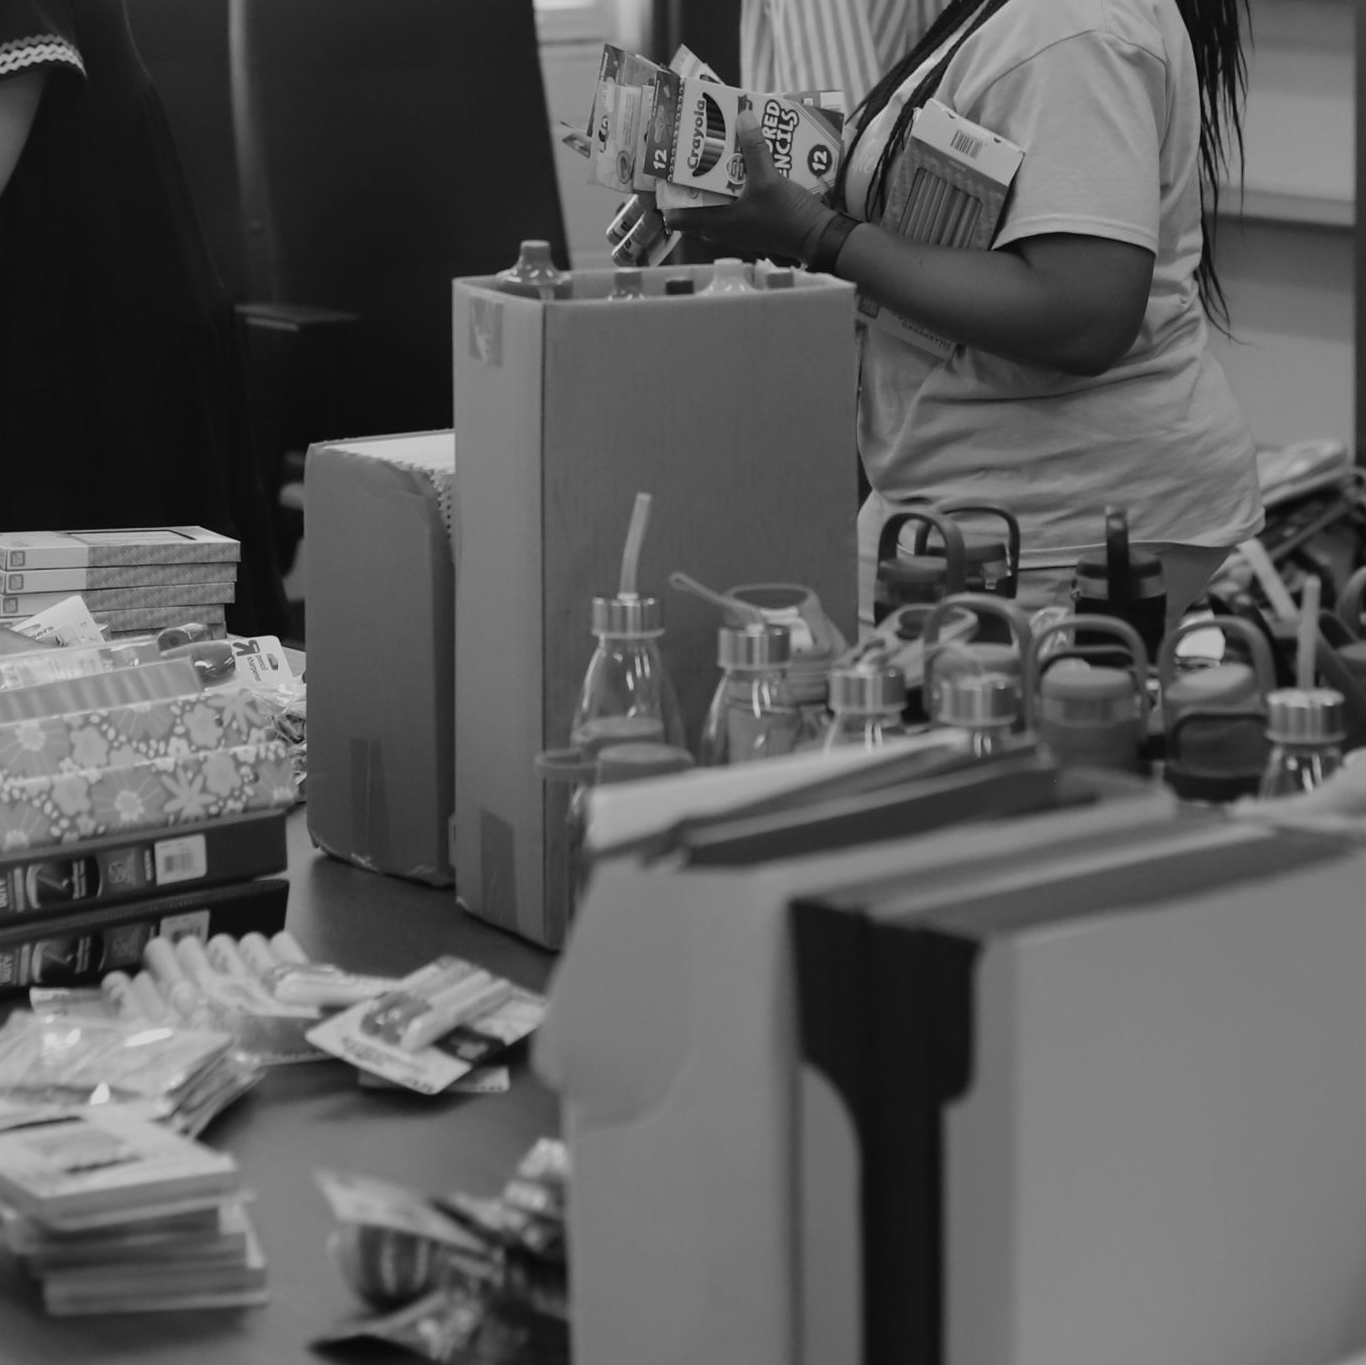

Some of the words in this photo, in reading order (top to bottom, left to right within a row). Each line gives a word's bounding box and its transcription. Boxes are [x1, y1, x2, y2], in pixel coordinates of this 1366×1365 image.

[687, 99, 706, 170] Crayola
[652, 148, 667, 170] 12
[811, 150, 828, 171] 12
